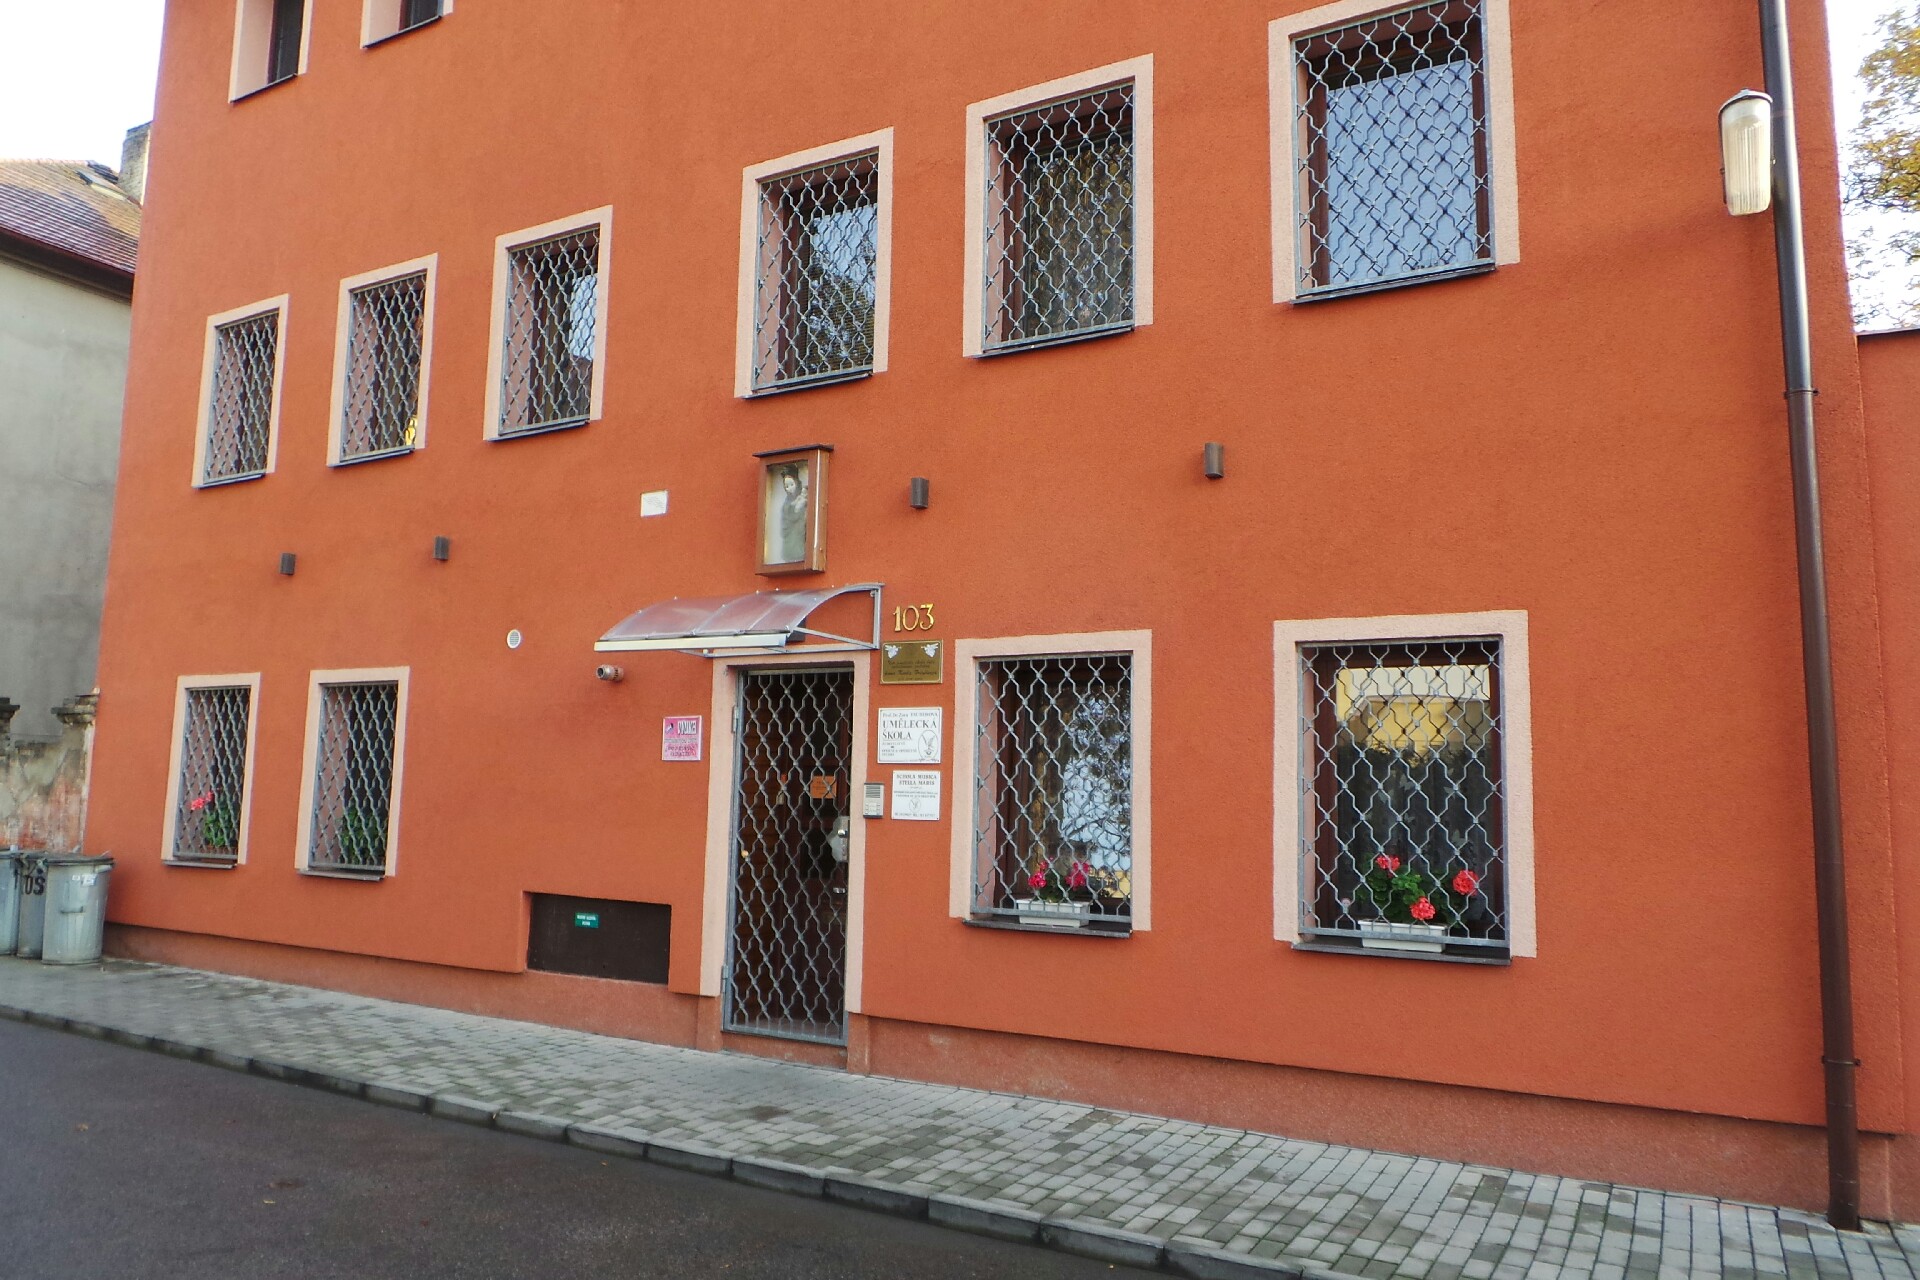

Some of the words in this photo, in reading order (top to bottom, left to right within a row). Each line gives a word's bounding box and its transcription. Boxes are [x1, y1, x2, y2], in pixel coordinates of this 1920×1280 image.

[893, 604, 934, 631] 103
[882, 717, 937, 729] UMĚLECKÁ
[882, 729, 912, 740] ŠKOLA
